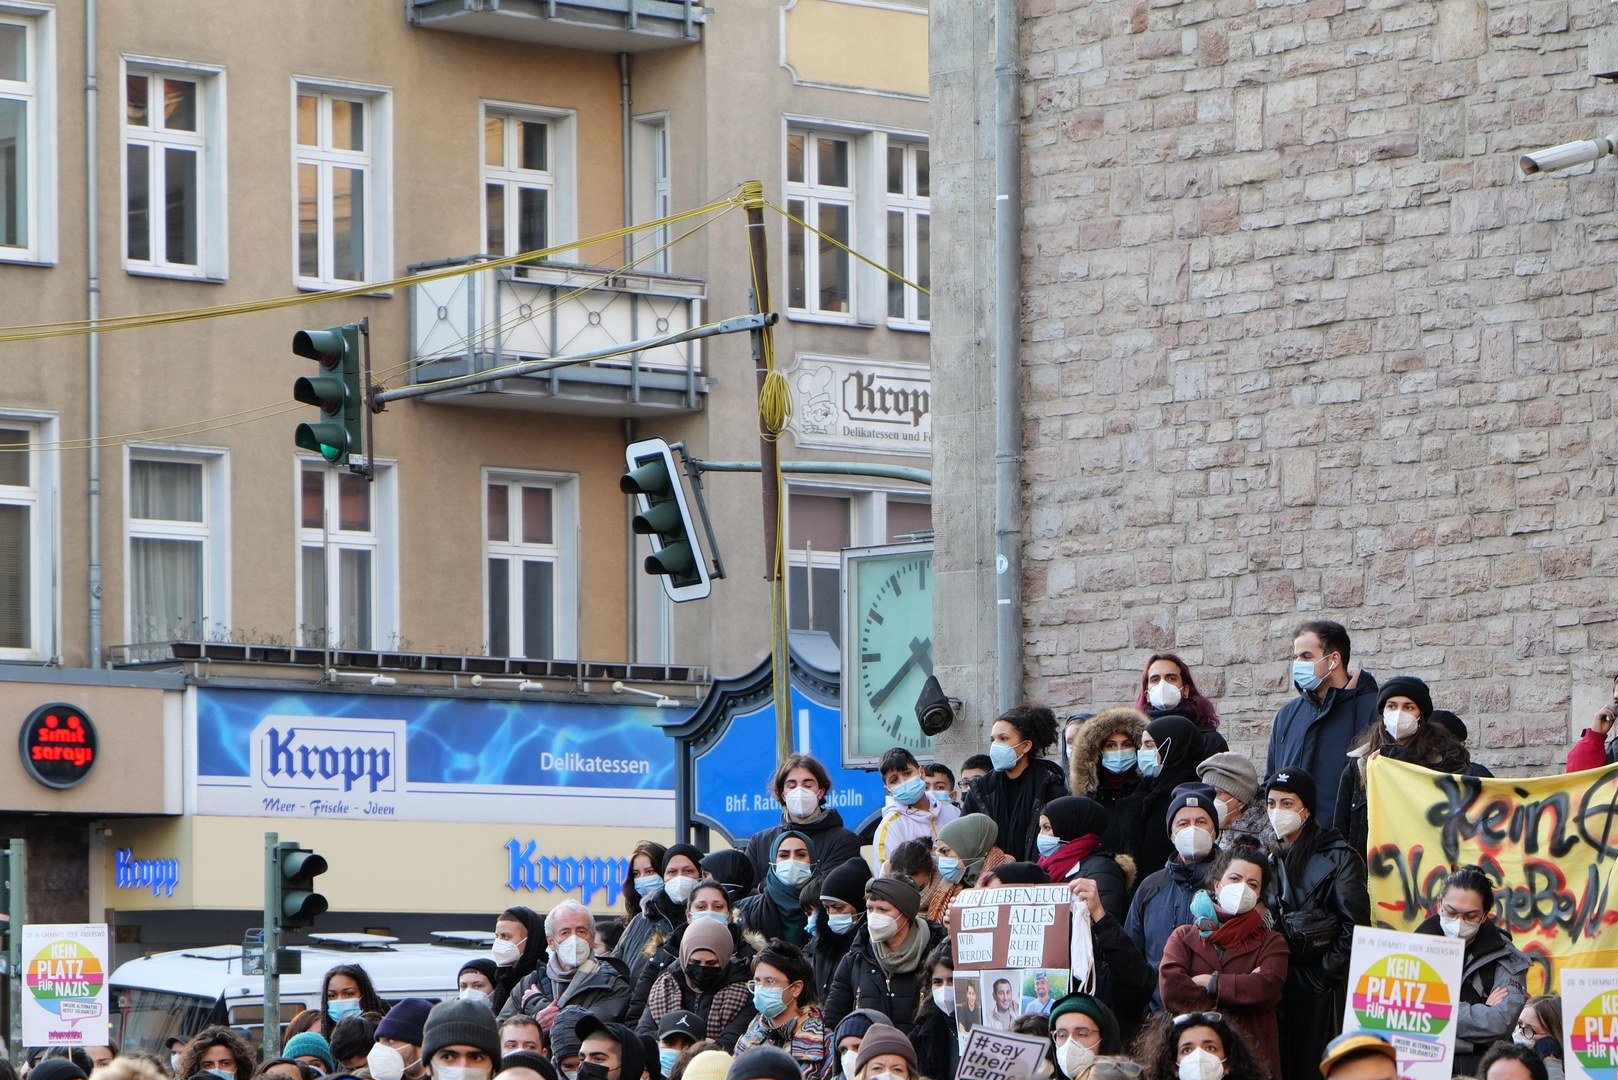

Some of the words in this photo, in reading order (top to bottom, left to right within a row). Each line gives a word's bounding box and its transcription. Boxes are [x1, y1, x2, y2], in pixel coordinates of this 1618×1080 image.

[842, 425, 899, 440] Delikatessen
[902, 431, 920, 441] und
[265, 727, 391, 793] Kropp
[540, 752, 650, 774] Delikatessen
[262, 798, 296, 812] Meer
[309, 800, 349, 816] Frische
[725, 794, 750, 812] Bhf.
[1425, 776, 1580, 866] Kein
[115, 848, 180, 897] Kropp
[957, 891, 982, 904] WIR
[983, 888, 1033, 904] LIEBEN
[1035, 887, 1070, 904] EUCH
[962, 910, 996, 929] ÜBER
[1010, 907, 1055, 924] ALLES
[1011, 925, 1042, 935] KEINE
[958, 935, 974, 945] WIR
[1009, 940, 1040, 951] RUHE
[51, 943, 77, 958] KEIN
[958, 950, 992, 961] WERDEN
[37, 960, 84, 980] PLATZ
[1007, 956, 1041, 967] GEBEN
[1386, 957, 1420, 980] KEIN
[38, 980, 53, 991] FÜR
[55, 981, 90, 997] NAZIS
[1366, 976, 1427, 1009] PLATZ
[1366, 1002, 1385, 1019] FÜR
[1386, 1008, 1432, 1033] NAZIS
[974, 1036, 1026, 1060] #say
[1586, 1041, 1607, 1058] FÜR
[967, 1050, 1015, 1072] their
